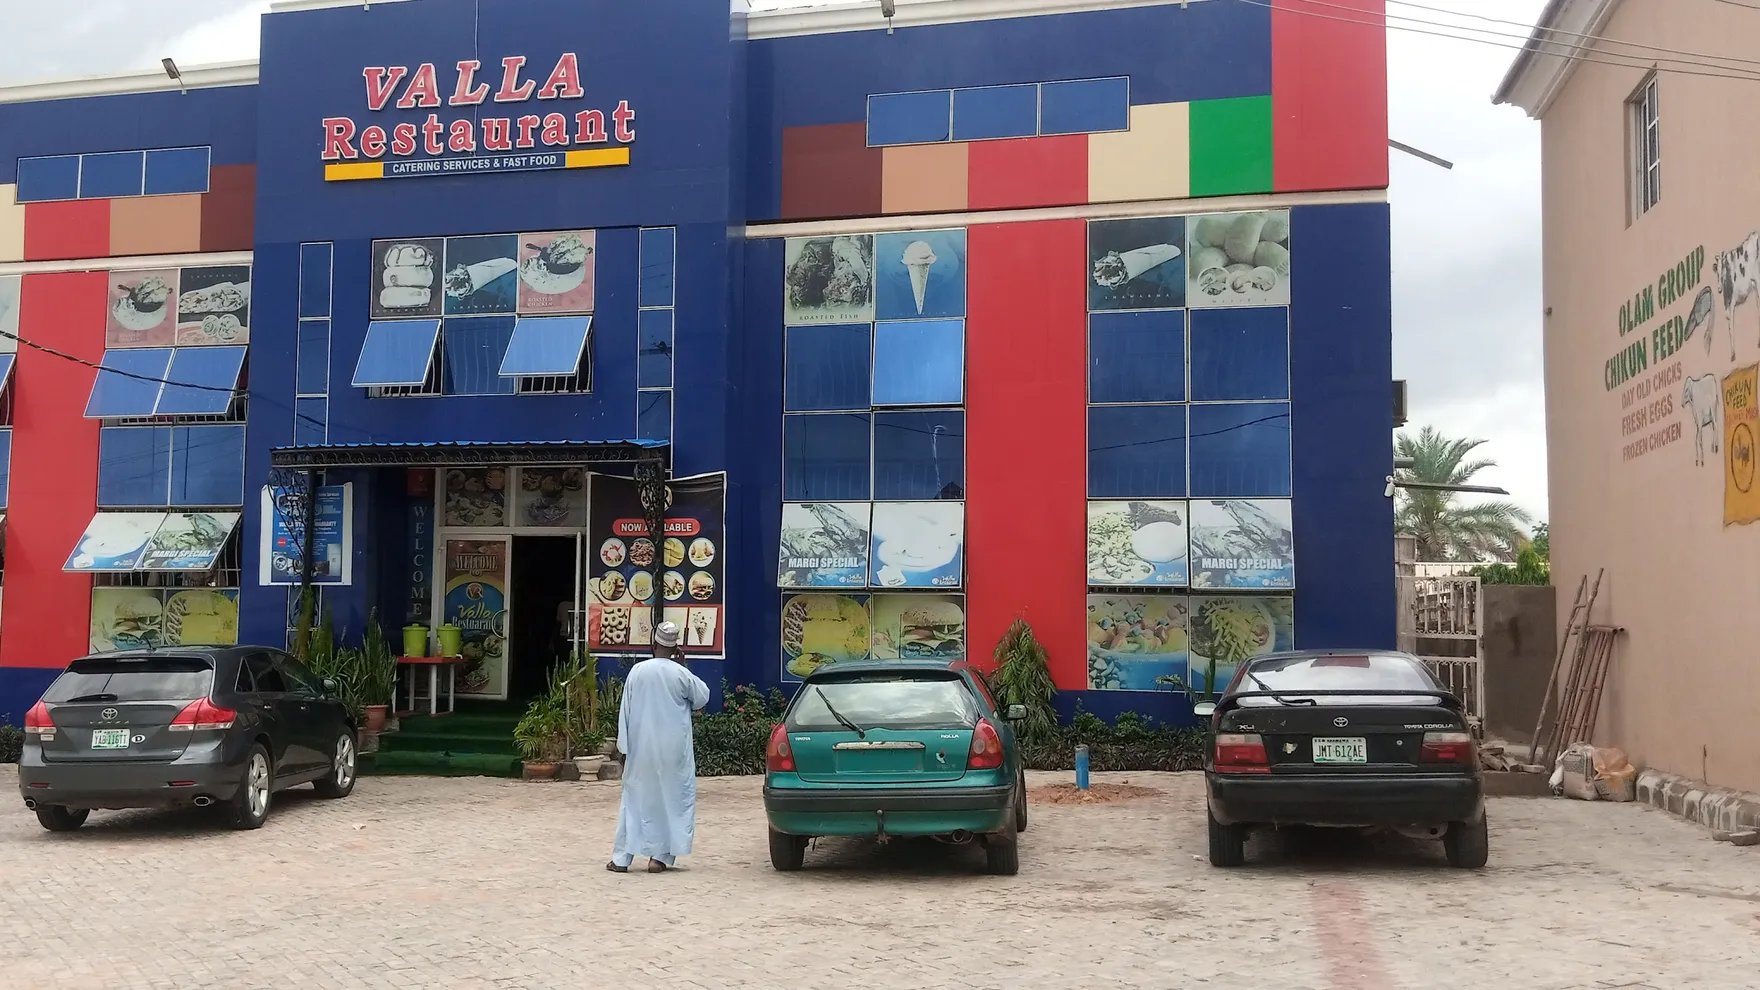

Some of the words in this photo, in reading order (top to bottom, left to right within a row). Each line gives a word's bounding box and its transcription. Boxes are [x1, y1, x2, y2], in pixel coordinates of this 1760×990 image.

[363, 52, 585, 112] VALLA
[321, 100, 636, 161] Restaurant
[392, 161, 441, 173] CATERING
[443, 158, 491, 170] SERVICES
[493, 156, 501, 168] &
[503, 156, 528, 168] FAST
[529, 155, 557, 166] FOOD
[1618, 284, 1655, 338] OLAM
[1658, 244, 1705, 311] GROUP
[1604, 336, 1648, 392] CHIKUN
[1652, 314, 1684, 366] FEED
[1621, 387, 1635, 411] DAY
[1636, 378, 1651, 401] OLD
[1653, 361, 1682, 393] CHICKS
[1725, 377, 1752, 407] CHIKUN
[1732, 393, 1748, 409] FEED
[1621, 406, 1647, 437] FRESH
[1649, 393, 1673, 425] EGGS
[1622, 436, 1649, 463] FROZEN
[1649, 421, 1682, 451] CHICKEN
[621, 523, 642, 532] NOW
[644, 522, 693, 532] ALABLE
[151, 550, 178, 558] MARGI
[178, 550, 211, 558] SPECIAL
[411, 506, 428, 616] WELCOME
[455, 555, 498, 569] WELCOME
[788, 558, 819, 569] MARGI
[820, 557, 859, 569] SPECIAL
[1201, 558, 1238, 569] MARGI
[1239, 558, 1284, 570] SPECIAL
[458, 602, 492, 619] Valla
[452, 616, 496, 630] Restuaran
